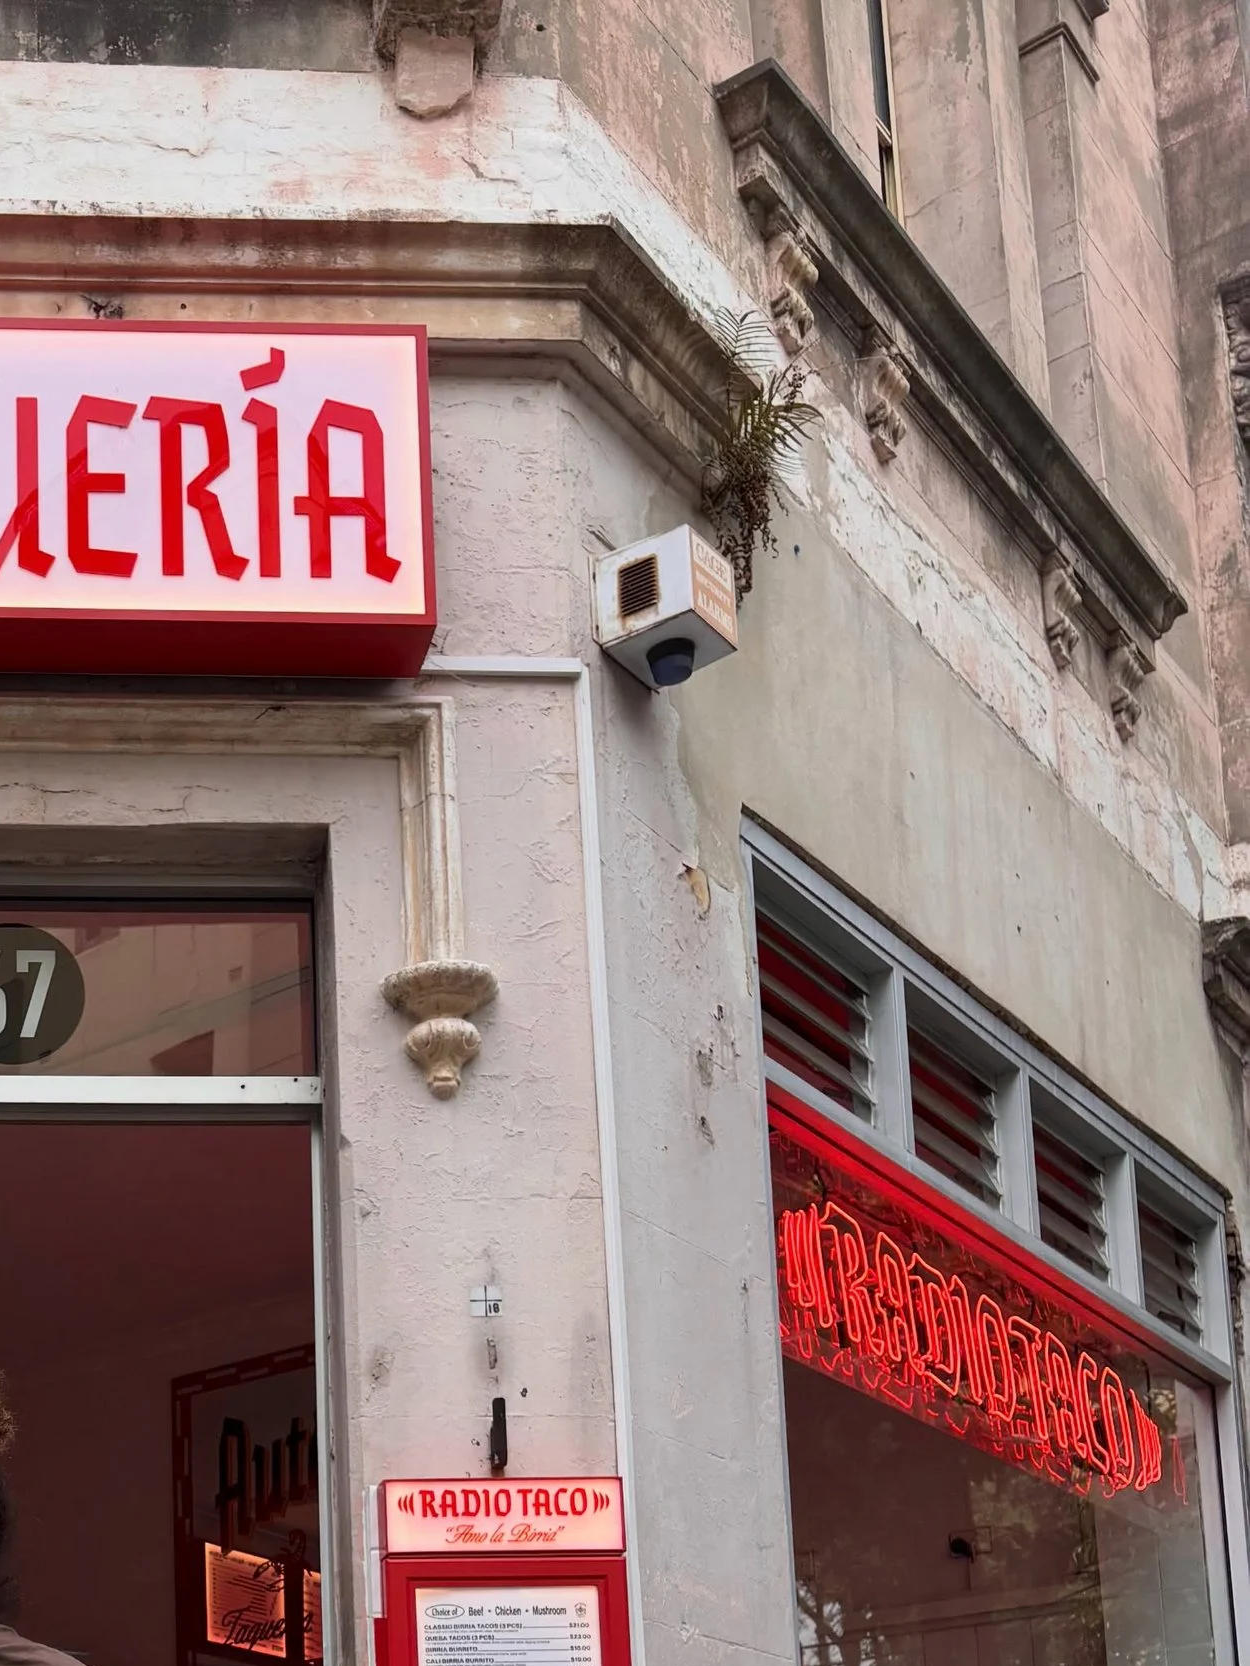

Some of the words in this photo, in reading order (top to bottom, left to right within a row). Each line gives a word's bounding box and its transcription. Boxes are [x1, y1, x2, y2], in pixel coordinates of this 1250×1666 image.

[698, 590, 734, 635] ALARMS
[818, 1200, 1017, 1422] RADIO
[1007, 1315, 1136, 1490] TACO
[419, 1489, 512, 1518] RADIO
[517, 1488, 588, 1516] TACO
[489, 1522, 504, 1543] la
[468, 1606, 484, 1617] Beef
[495, 1605, 522, 1616] Chicken
[532, 1605, 567, 1616] Mushroom
